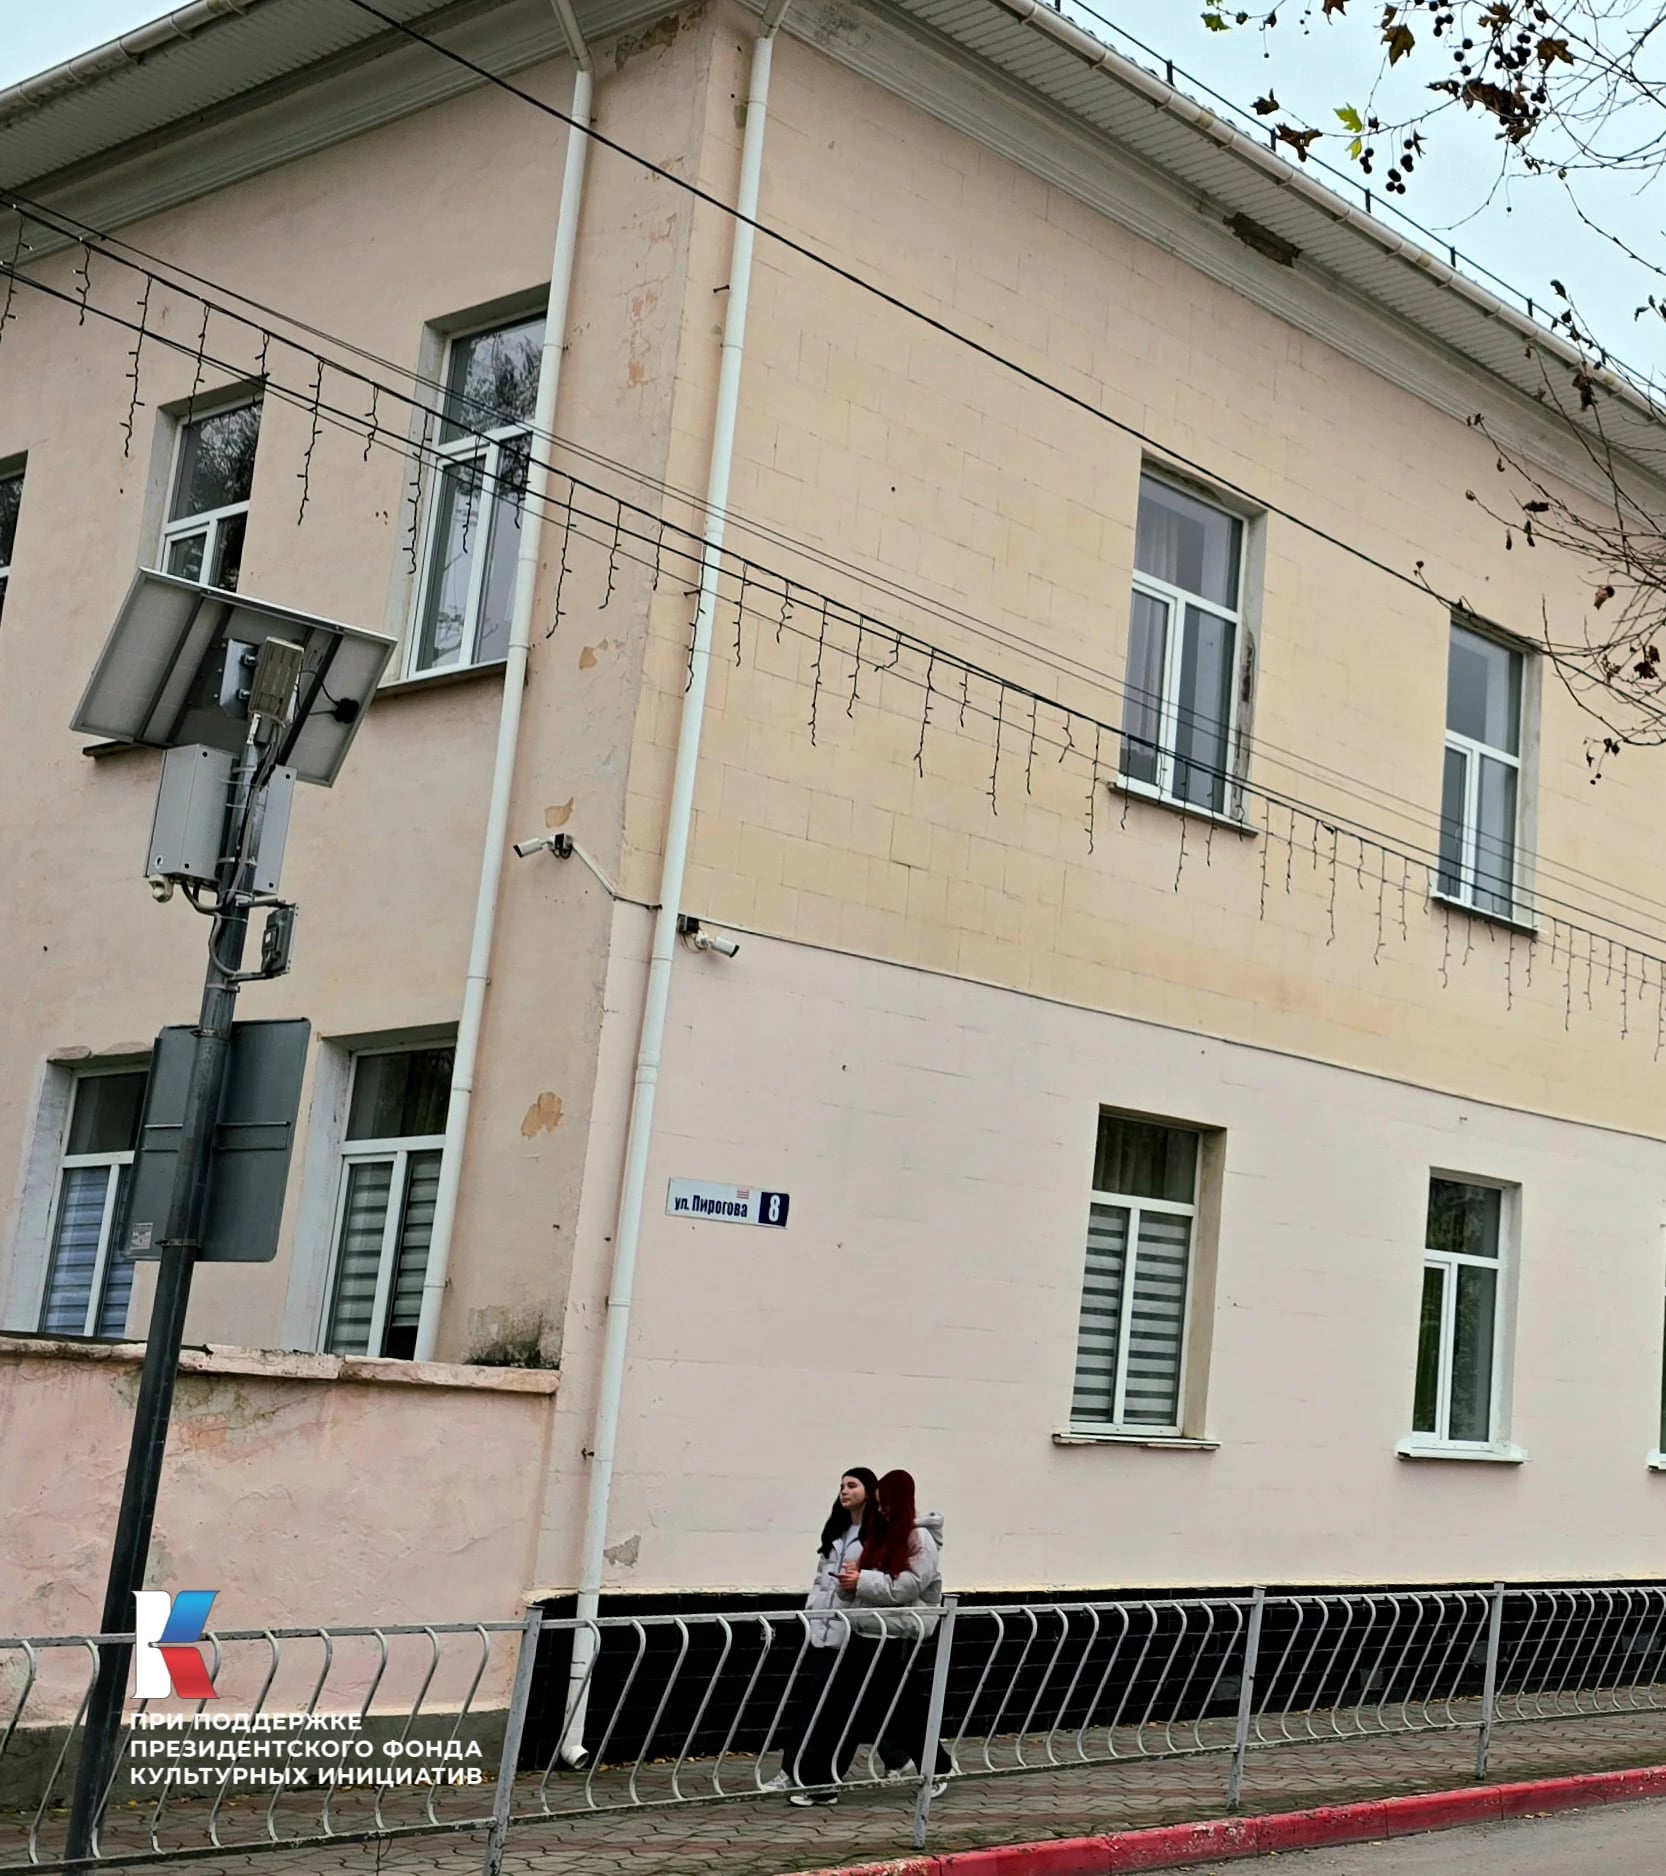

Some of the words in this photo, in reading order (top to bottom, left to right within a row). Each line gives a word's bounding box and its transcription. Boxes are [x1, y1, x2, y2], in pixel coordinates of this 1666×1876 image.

[674, 1196, 690, 1211] ул.
[692, 1194, 748, 1218] Пирогова
[768, 1194, 781, 1222] 8
